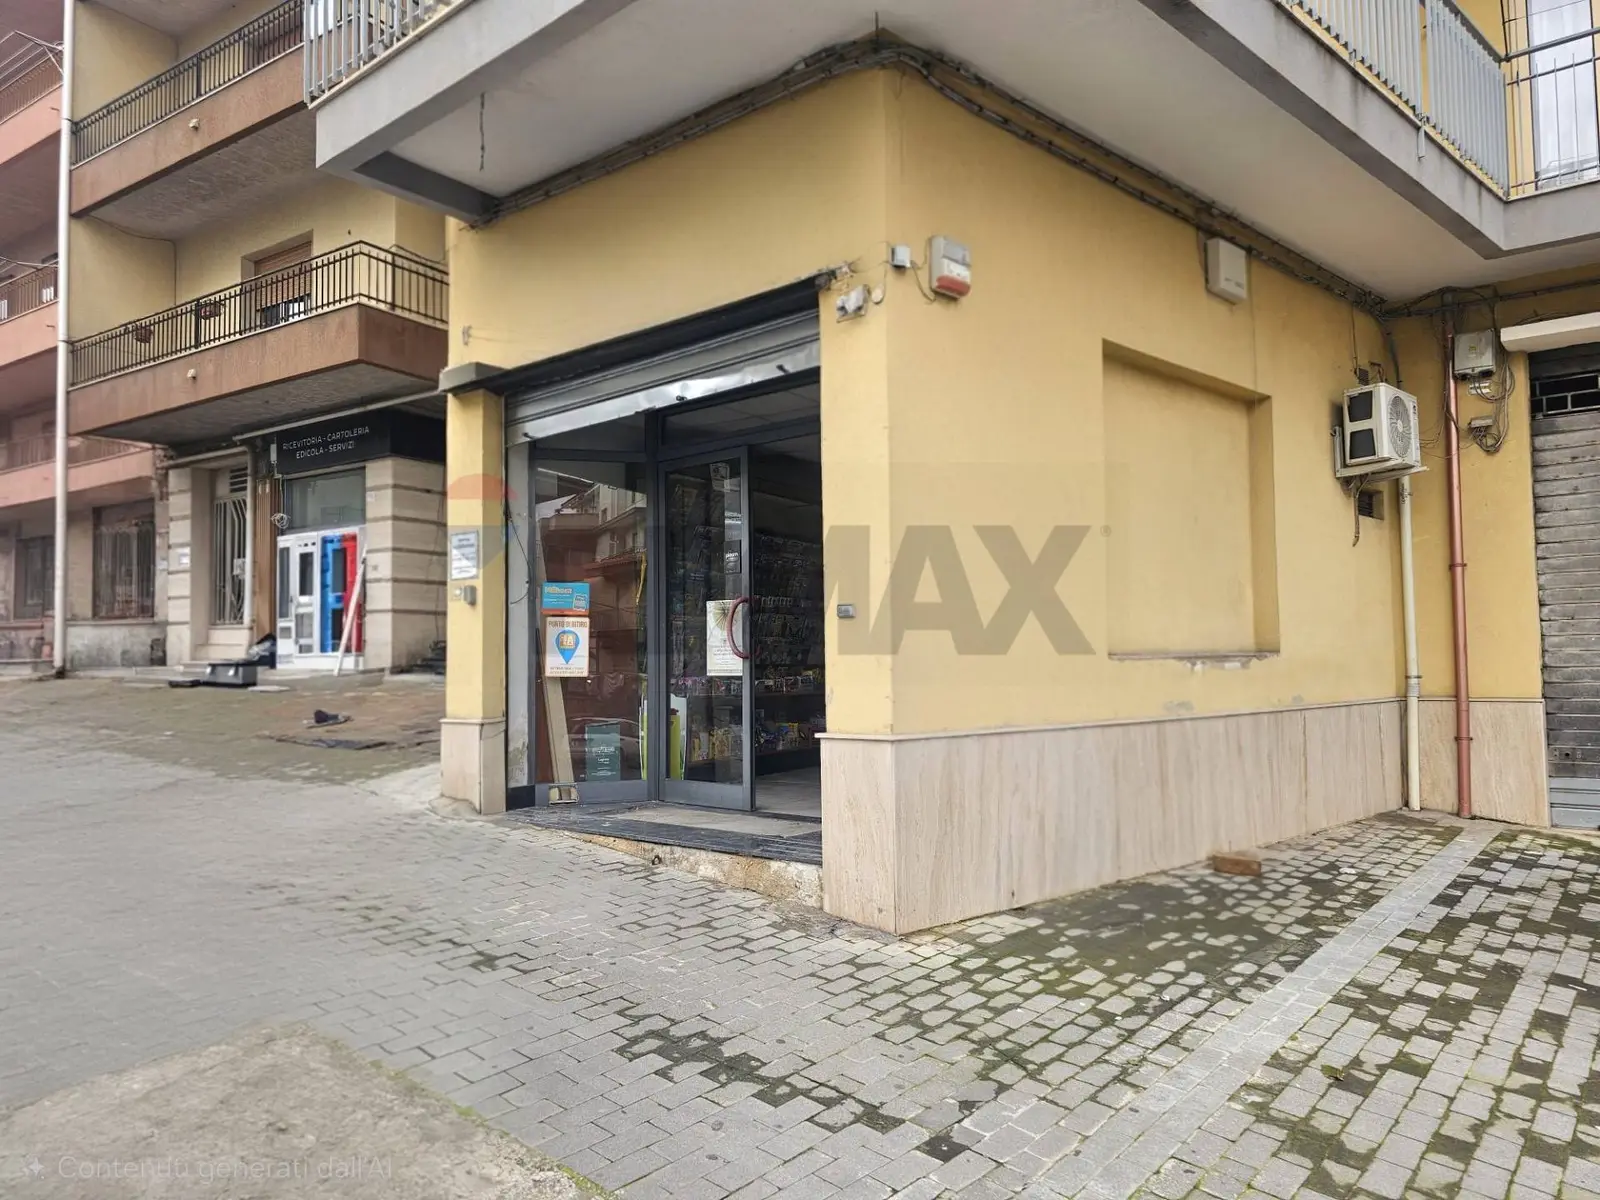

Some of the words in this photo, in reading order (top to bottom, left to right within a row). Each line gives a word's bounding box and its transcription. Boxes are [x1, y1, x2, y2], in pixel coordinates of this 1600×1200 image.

[283, 435, 322, 450] RICEVITORIA
[326, 426, 370, 442] CARTOLERIA
[296, 446, 324, 459] EDICOLA
[328, 440, 355, 453] SERVIZI
